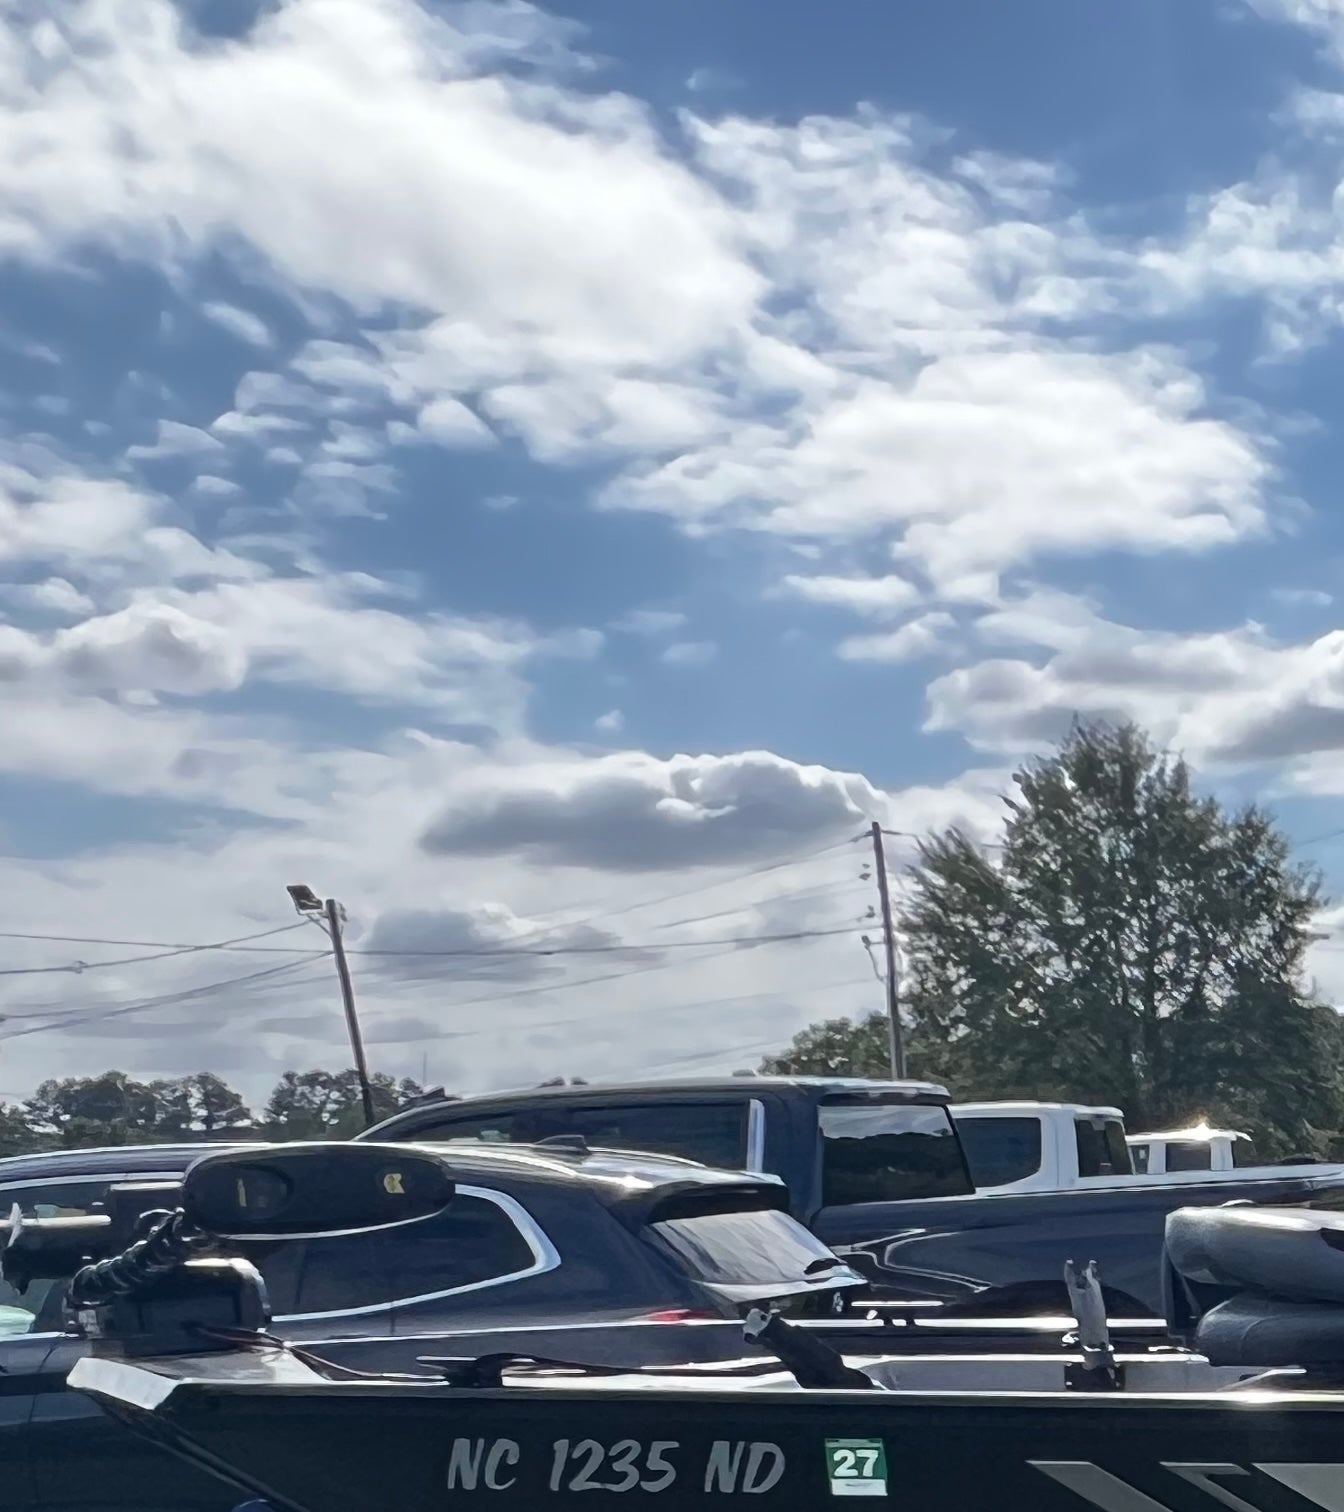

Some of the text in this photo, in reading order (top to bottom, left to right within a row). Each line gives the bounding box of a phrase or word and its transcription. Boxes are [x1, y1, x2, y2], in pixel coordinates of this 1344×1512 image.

[447, 1438, 785, 1494] NC 1235 ND
[833, 1449, 879, 1477] 27
